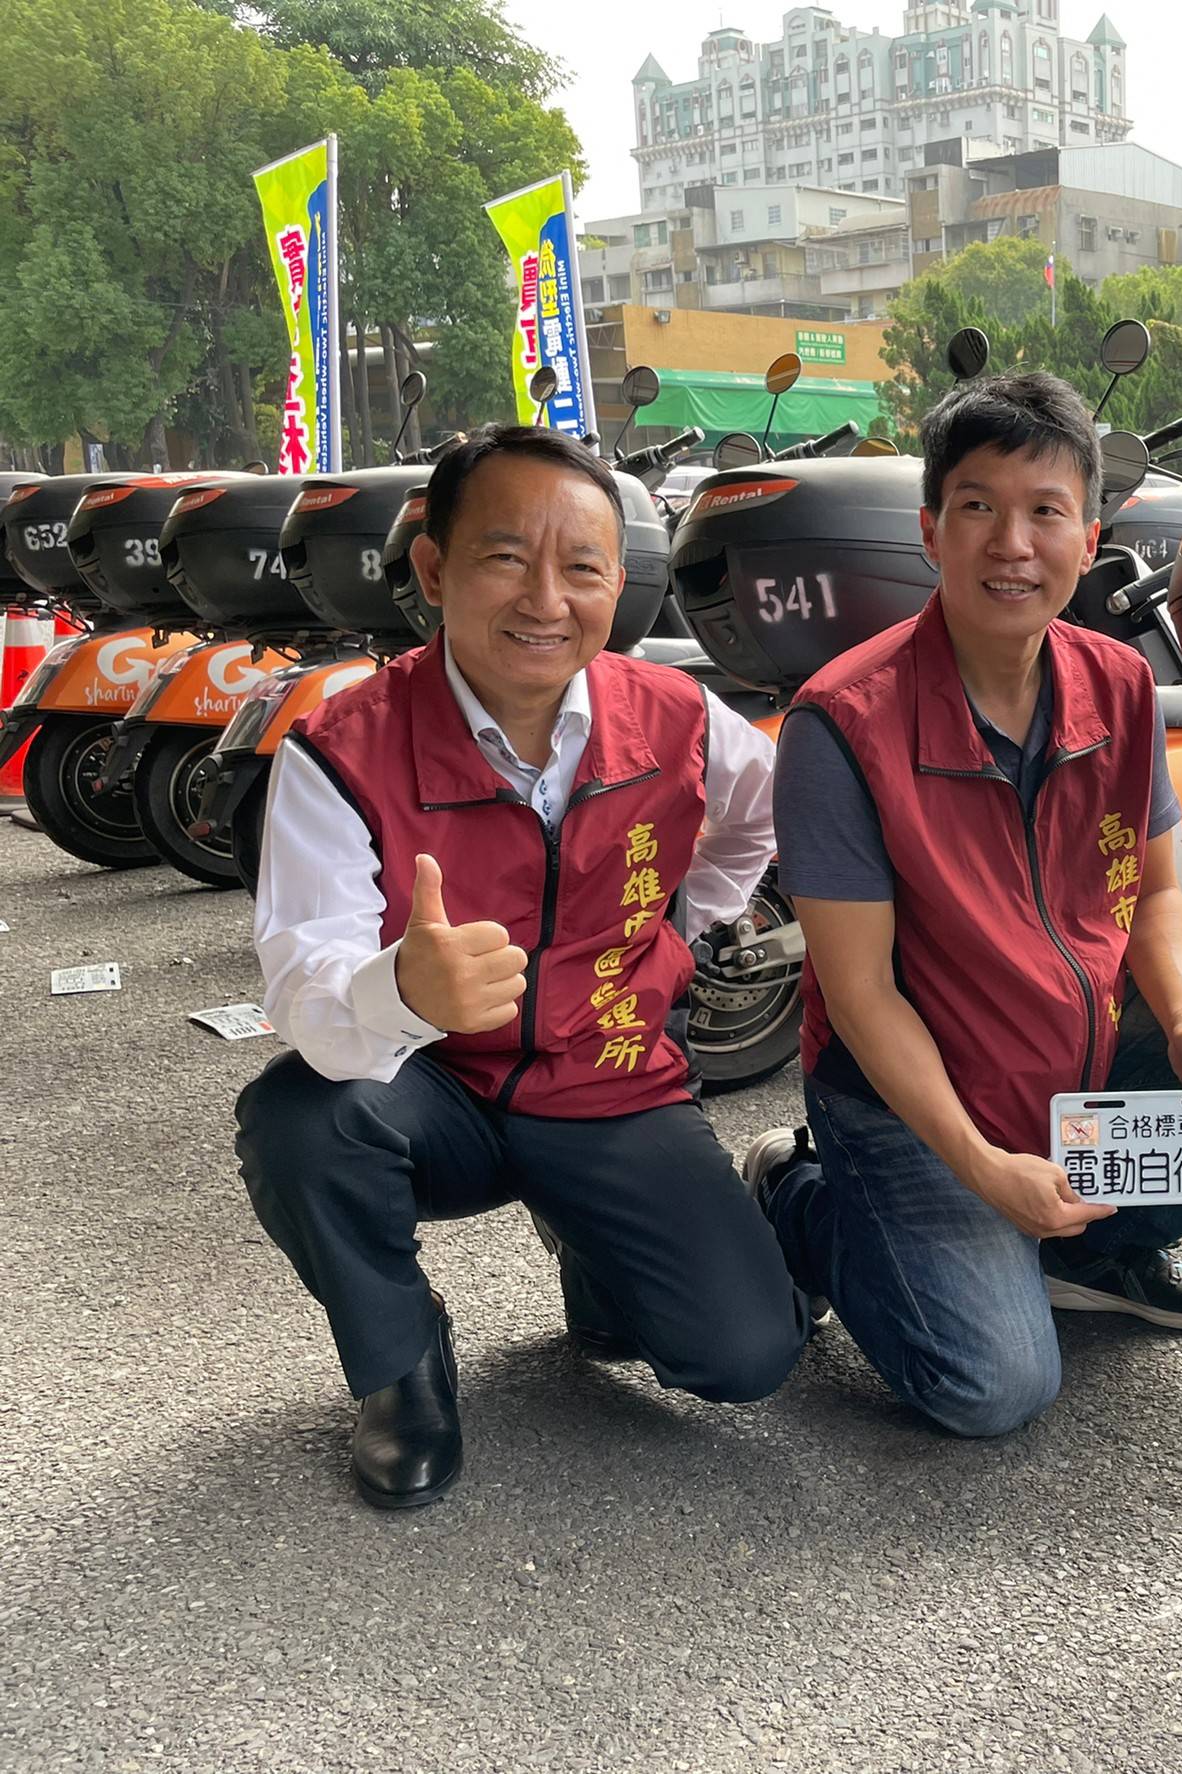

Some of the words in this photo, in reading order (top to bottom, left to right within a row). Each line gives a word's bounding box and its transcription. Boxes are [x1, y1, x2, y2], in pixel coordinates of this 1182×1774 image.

[710, 488, 763, 508] Rental
[24, 522, 67, 550] 652
[124, 538, 163, 567] 39
[249, 550, 288, 580] 74
[756, 573, 836, 622] 541
[85, 677, 137, 706] sharin
